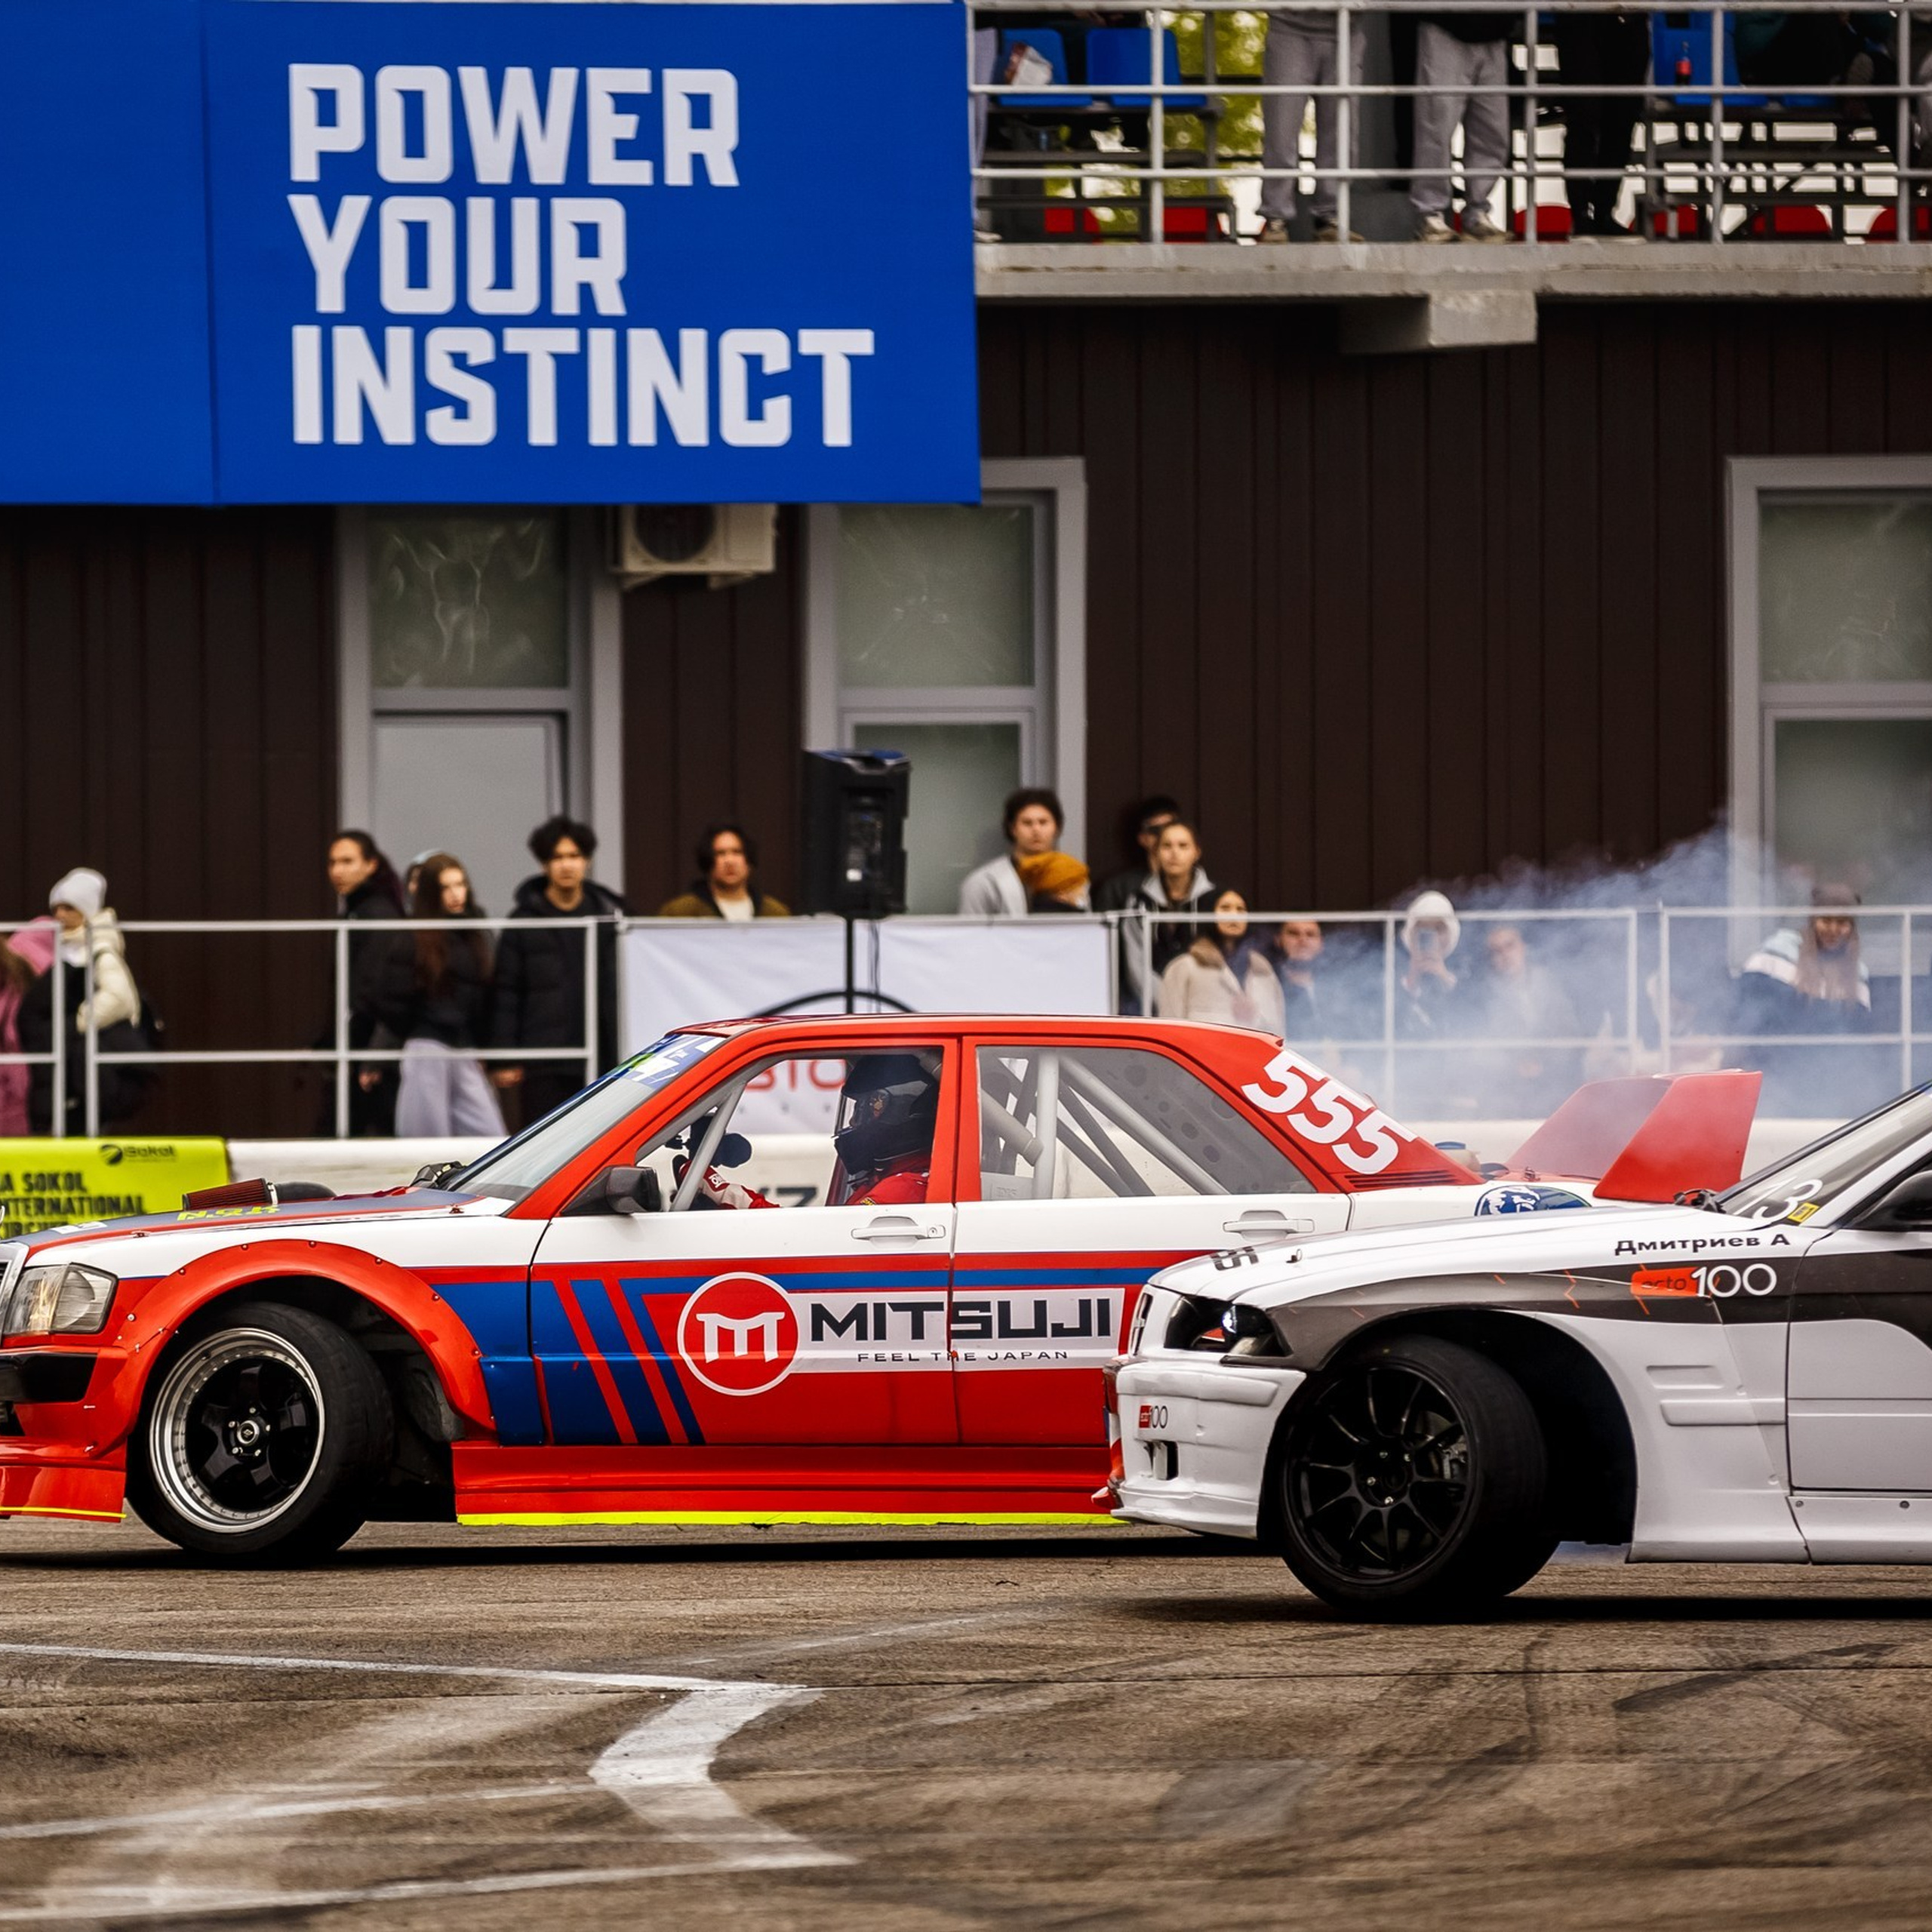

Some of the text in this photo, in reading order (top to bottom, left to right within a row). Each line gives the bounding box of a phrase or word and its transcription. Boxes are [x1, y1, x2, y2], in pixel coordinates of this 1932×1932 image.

[288, 63, 740, 187] POWER
[287, 193, 628, 317] YOUR
[291, 324, 875, 448] INSTINCT
[1241, 1050, 1418, 1174] 555
[22, 1171, 88, 1192] SOKOL
[1614, 1236, 1761, 1257] Дмитриев
[1690, 1262, 1778, 1298] 100
[810, 1297, 1111, 1343] MITSUJI
[857, 1350, 1069, 1362] FEEL THE JAPAN
